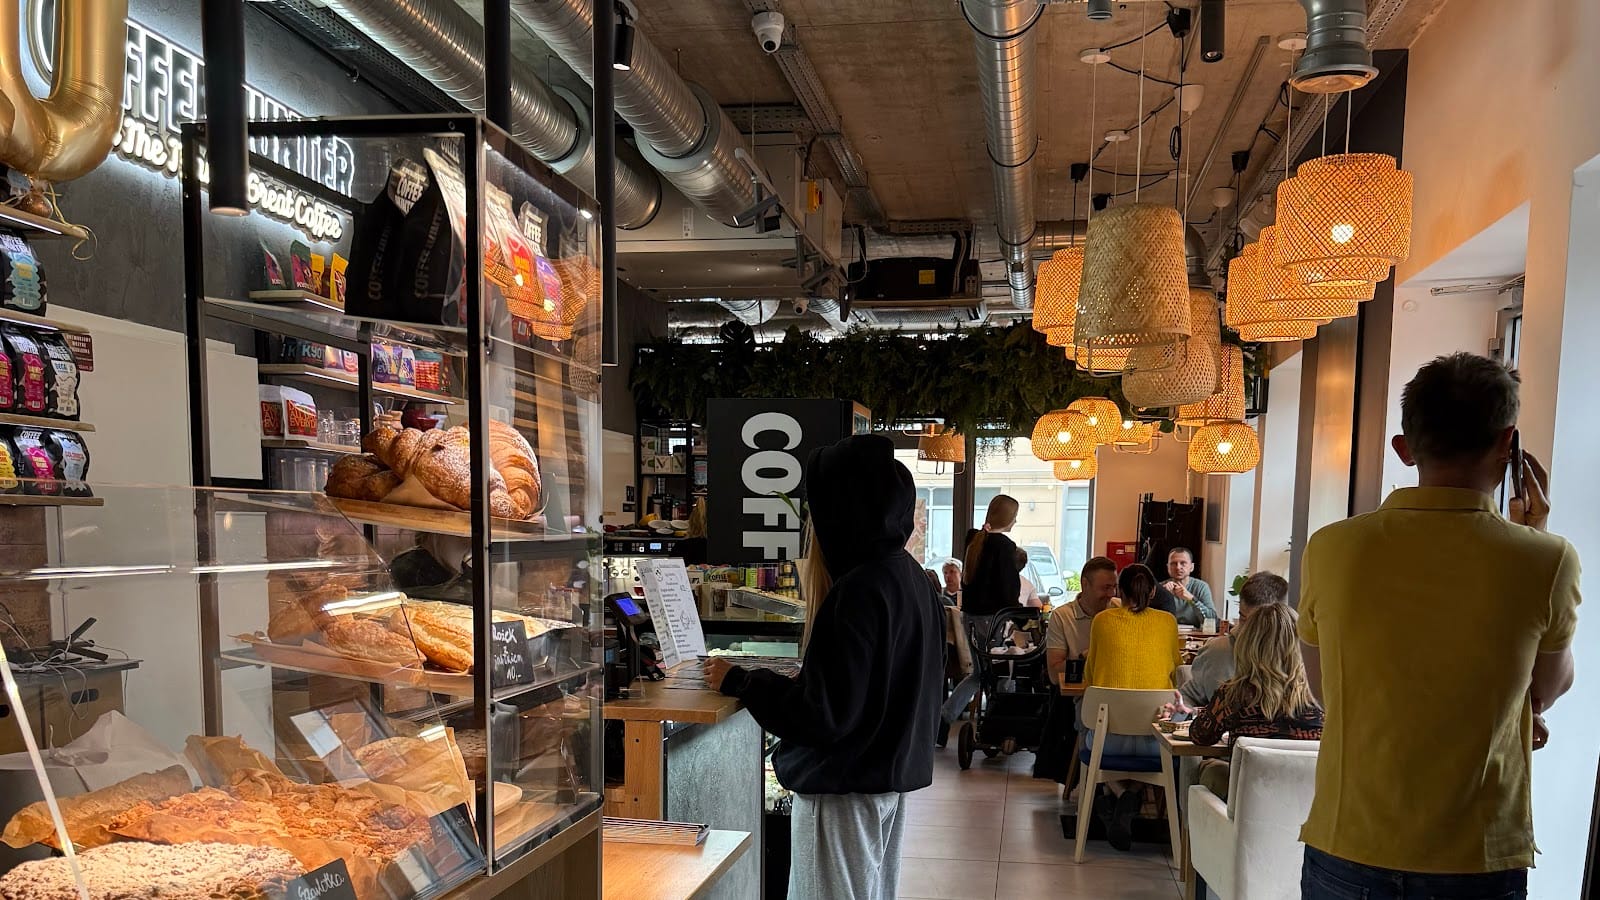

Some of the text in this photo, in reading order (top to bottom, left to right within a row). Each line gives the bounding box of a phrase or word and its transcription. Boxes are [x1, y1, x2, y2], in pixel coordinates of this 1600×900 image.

[121, 117, 168, 166] The
[247, 172, 295, 218] Great
[295, 195, 343, 239] Coffee
